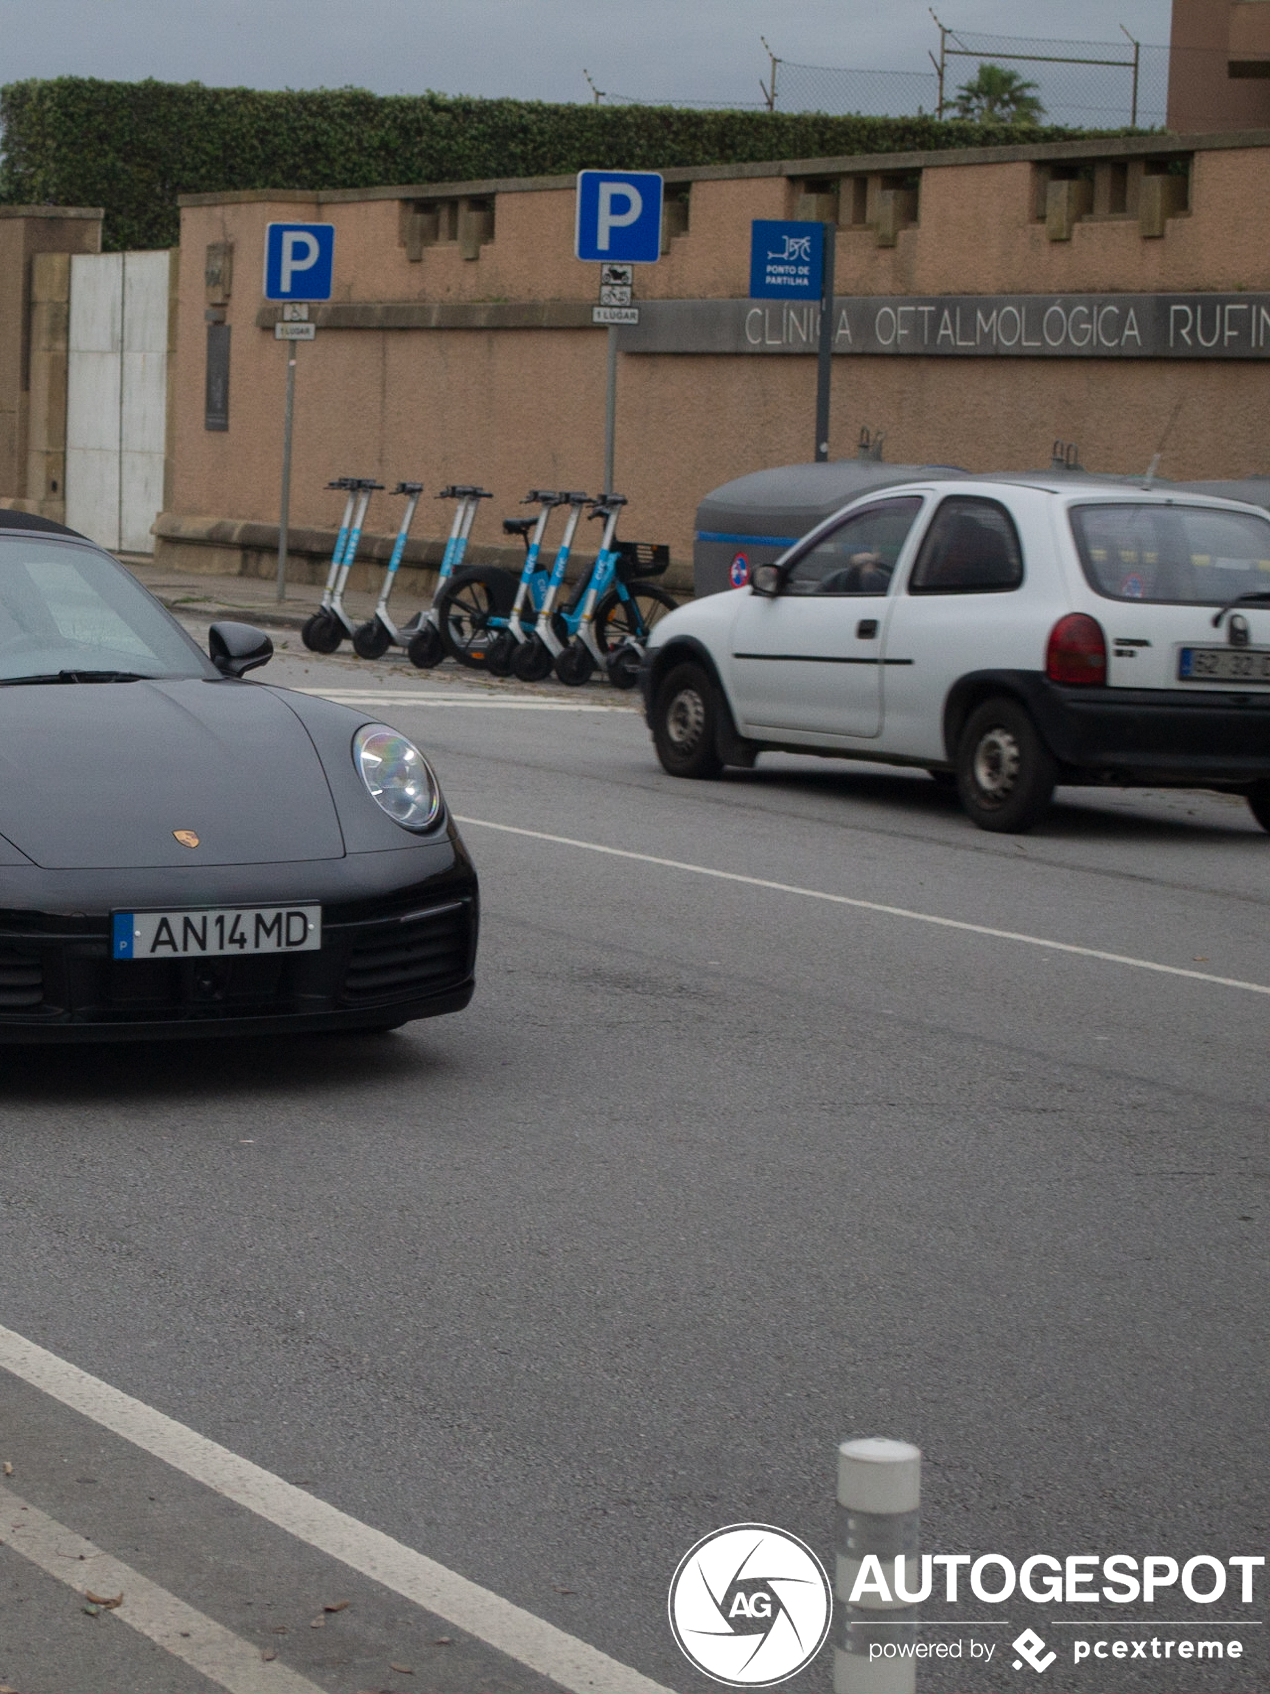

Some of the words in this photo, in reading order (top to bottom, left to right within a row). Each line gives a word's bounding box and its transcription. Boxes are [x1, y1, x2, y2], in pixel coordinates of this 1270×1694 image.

[596, 181, 643, 251] P
[280, 230, 320, 293] P
[766, 265, 797, 274] PONTO
[798, 266, 810, 275] DE
[765, 275, 809, 286] PARTILHA
[603, 310, 636, 320] LUGAR
[875, 300, 1142, 347] OFTALMOLÓGICA
